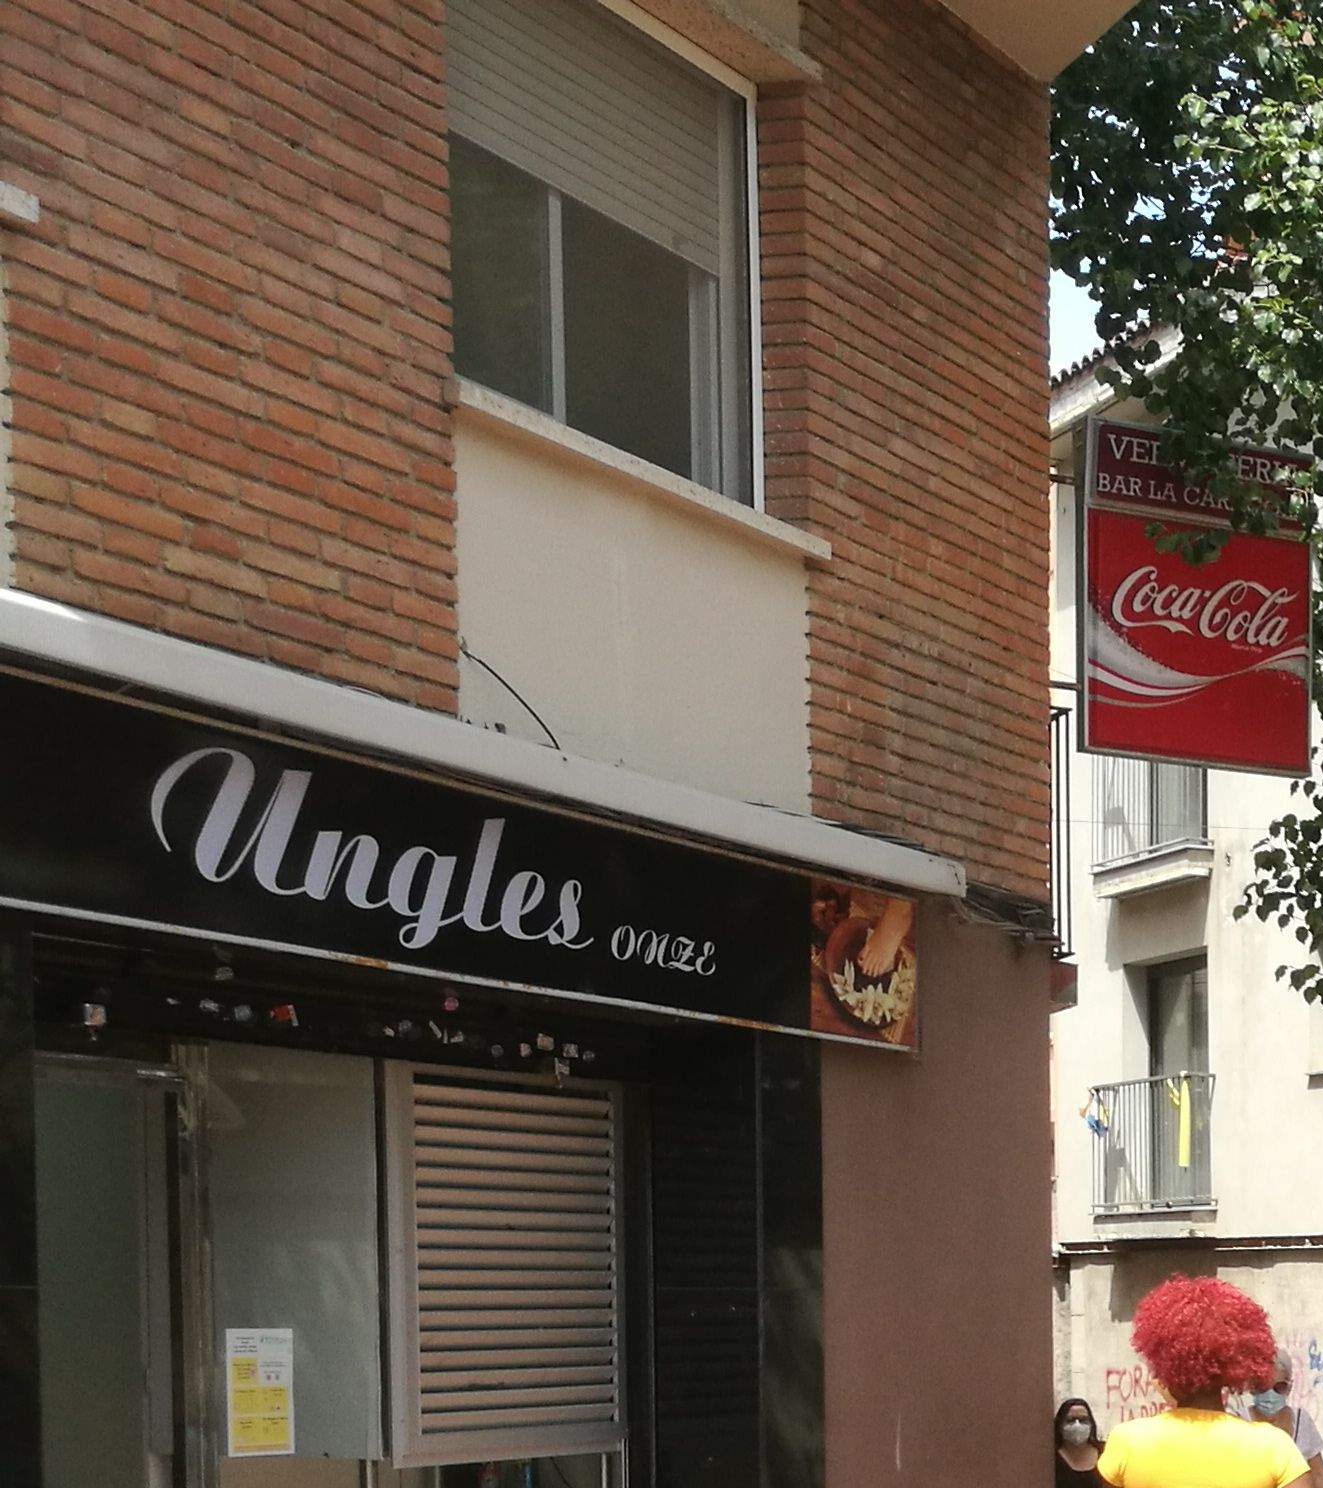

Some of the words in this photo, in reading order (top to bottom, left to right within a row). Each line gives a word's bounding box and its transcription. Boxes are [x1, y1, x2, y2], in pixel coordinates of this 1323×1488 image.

[1097, 472, 1143, 497] BAR
[1150, 480, 1177, 503] LA
[150, 746, 595, 950] Ungles
